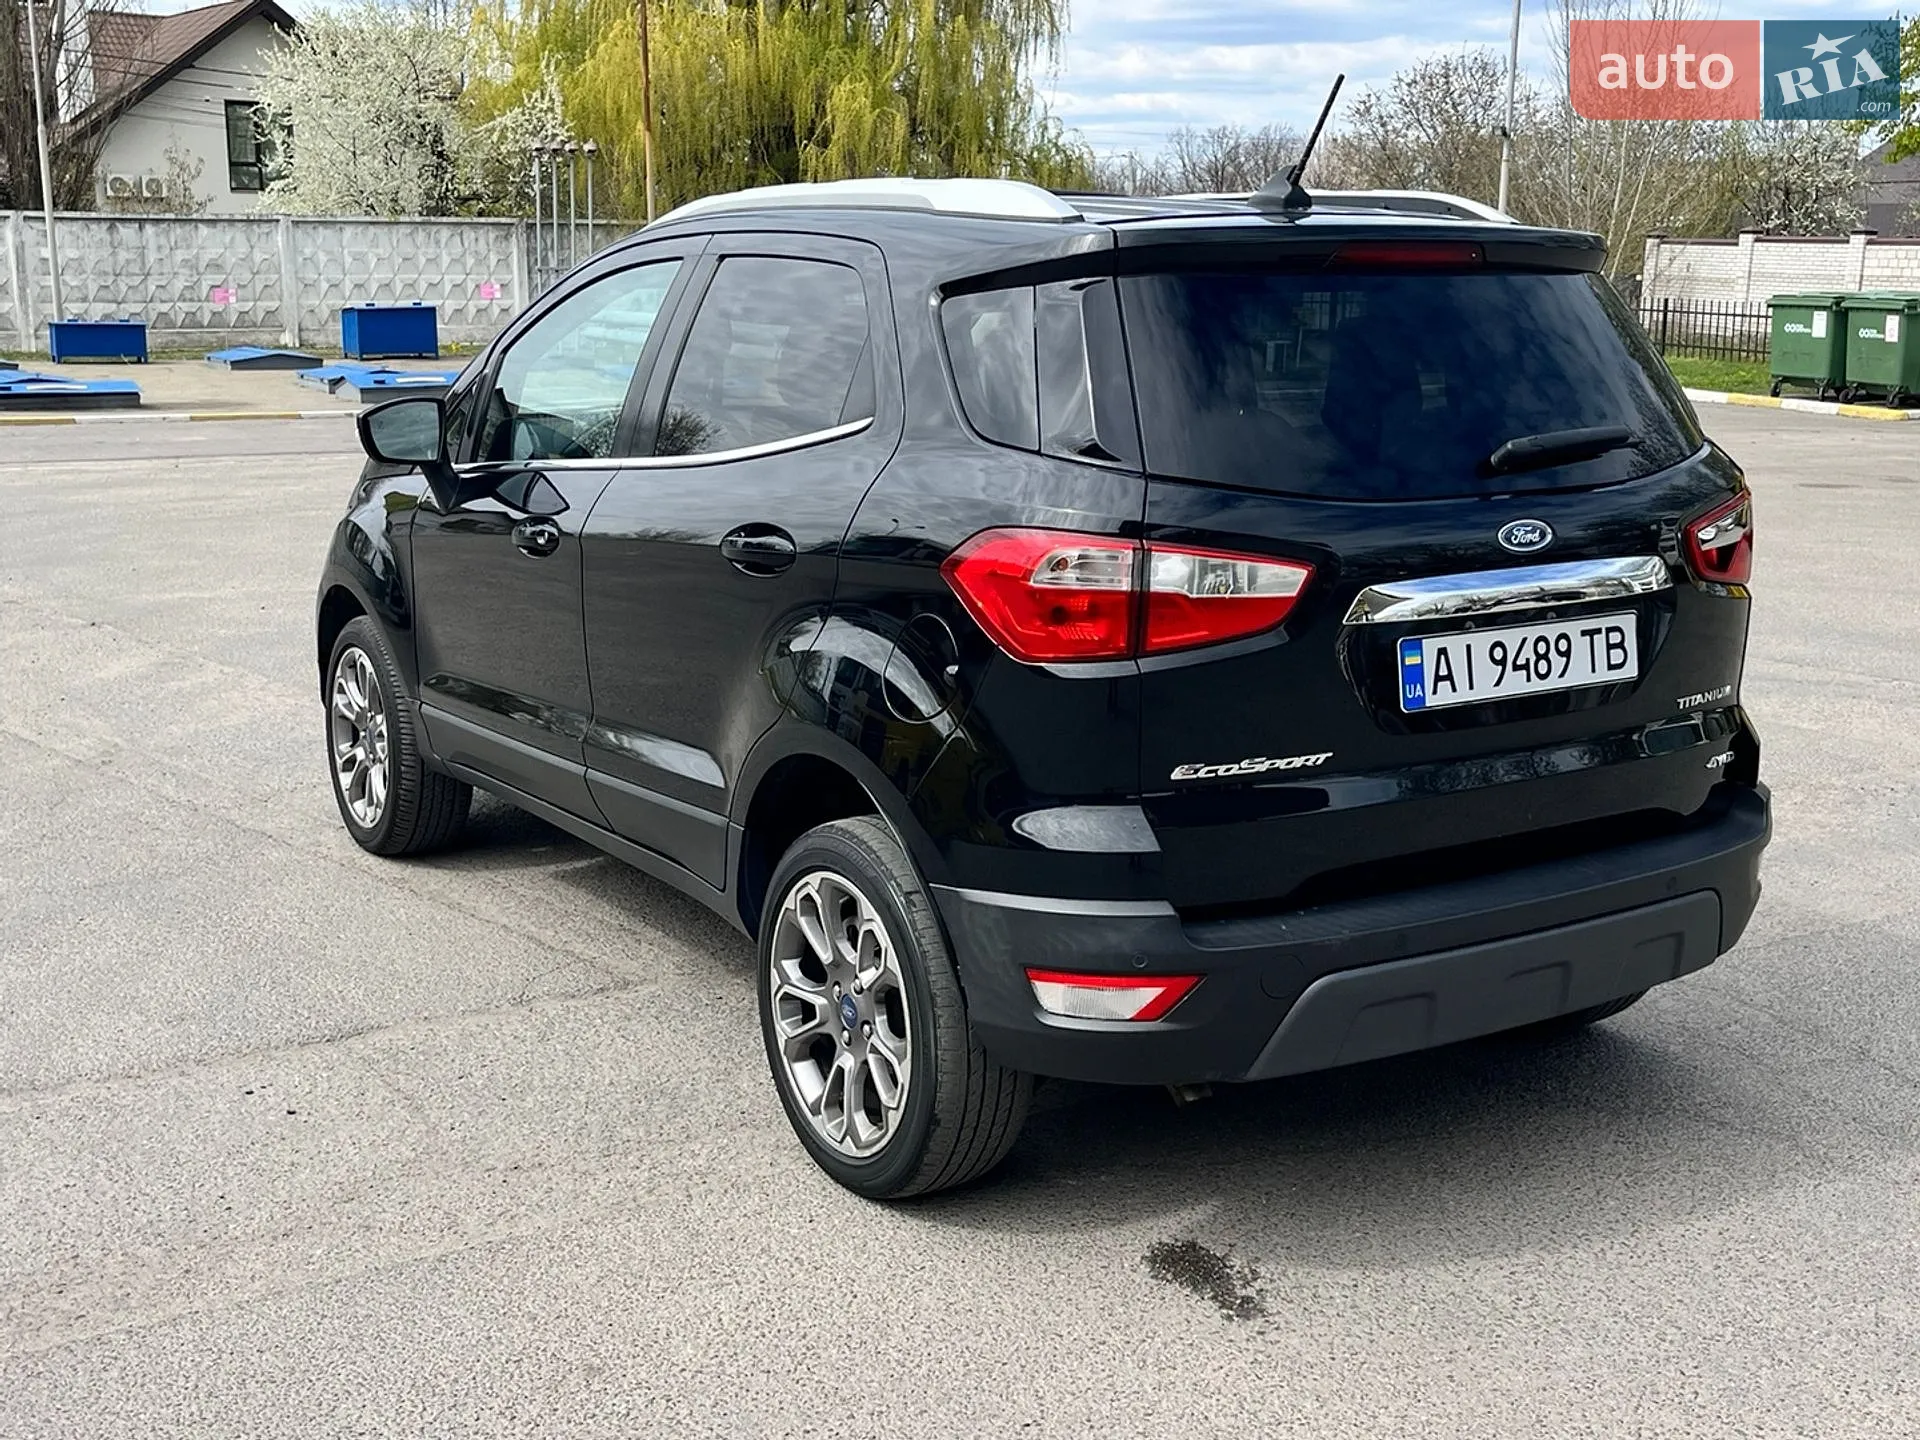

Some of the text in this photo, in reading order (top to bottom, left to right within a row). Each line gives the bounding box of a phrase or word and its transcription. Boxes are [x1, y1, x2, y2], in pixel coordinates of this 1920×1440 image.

[1510, 526, 1541, 544] Ford
[1431, 625, 1628, 696] AI 9489 TB
[1406, 682, 1424, 699] UA
[1676, 684, 1732, 710] TITANIUM
